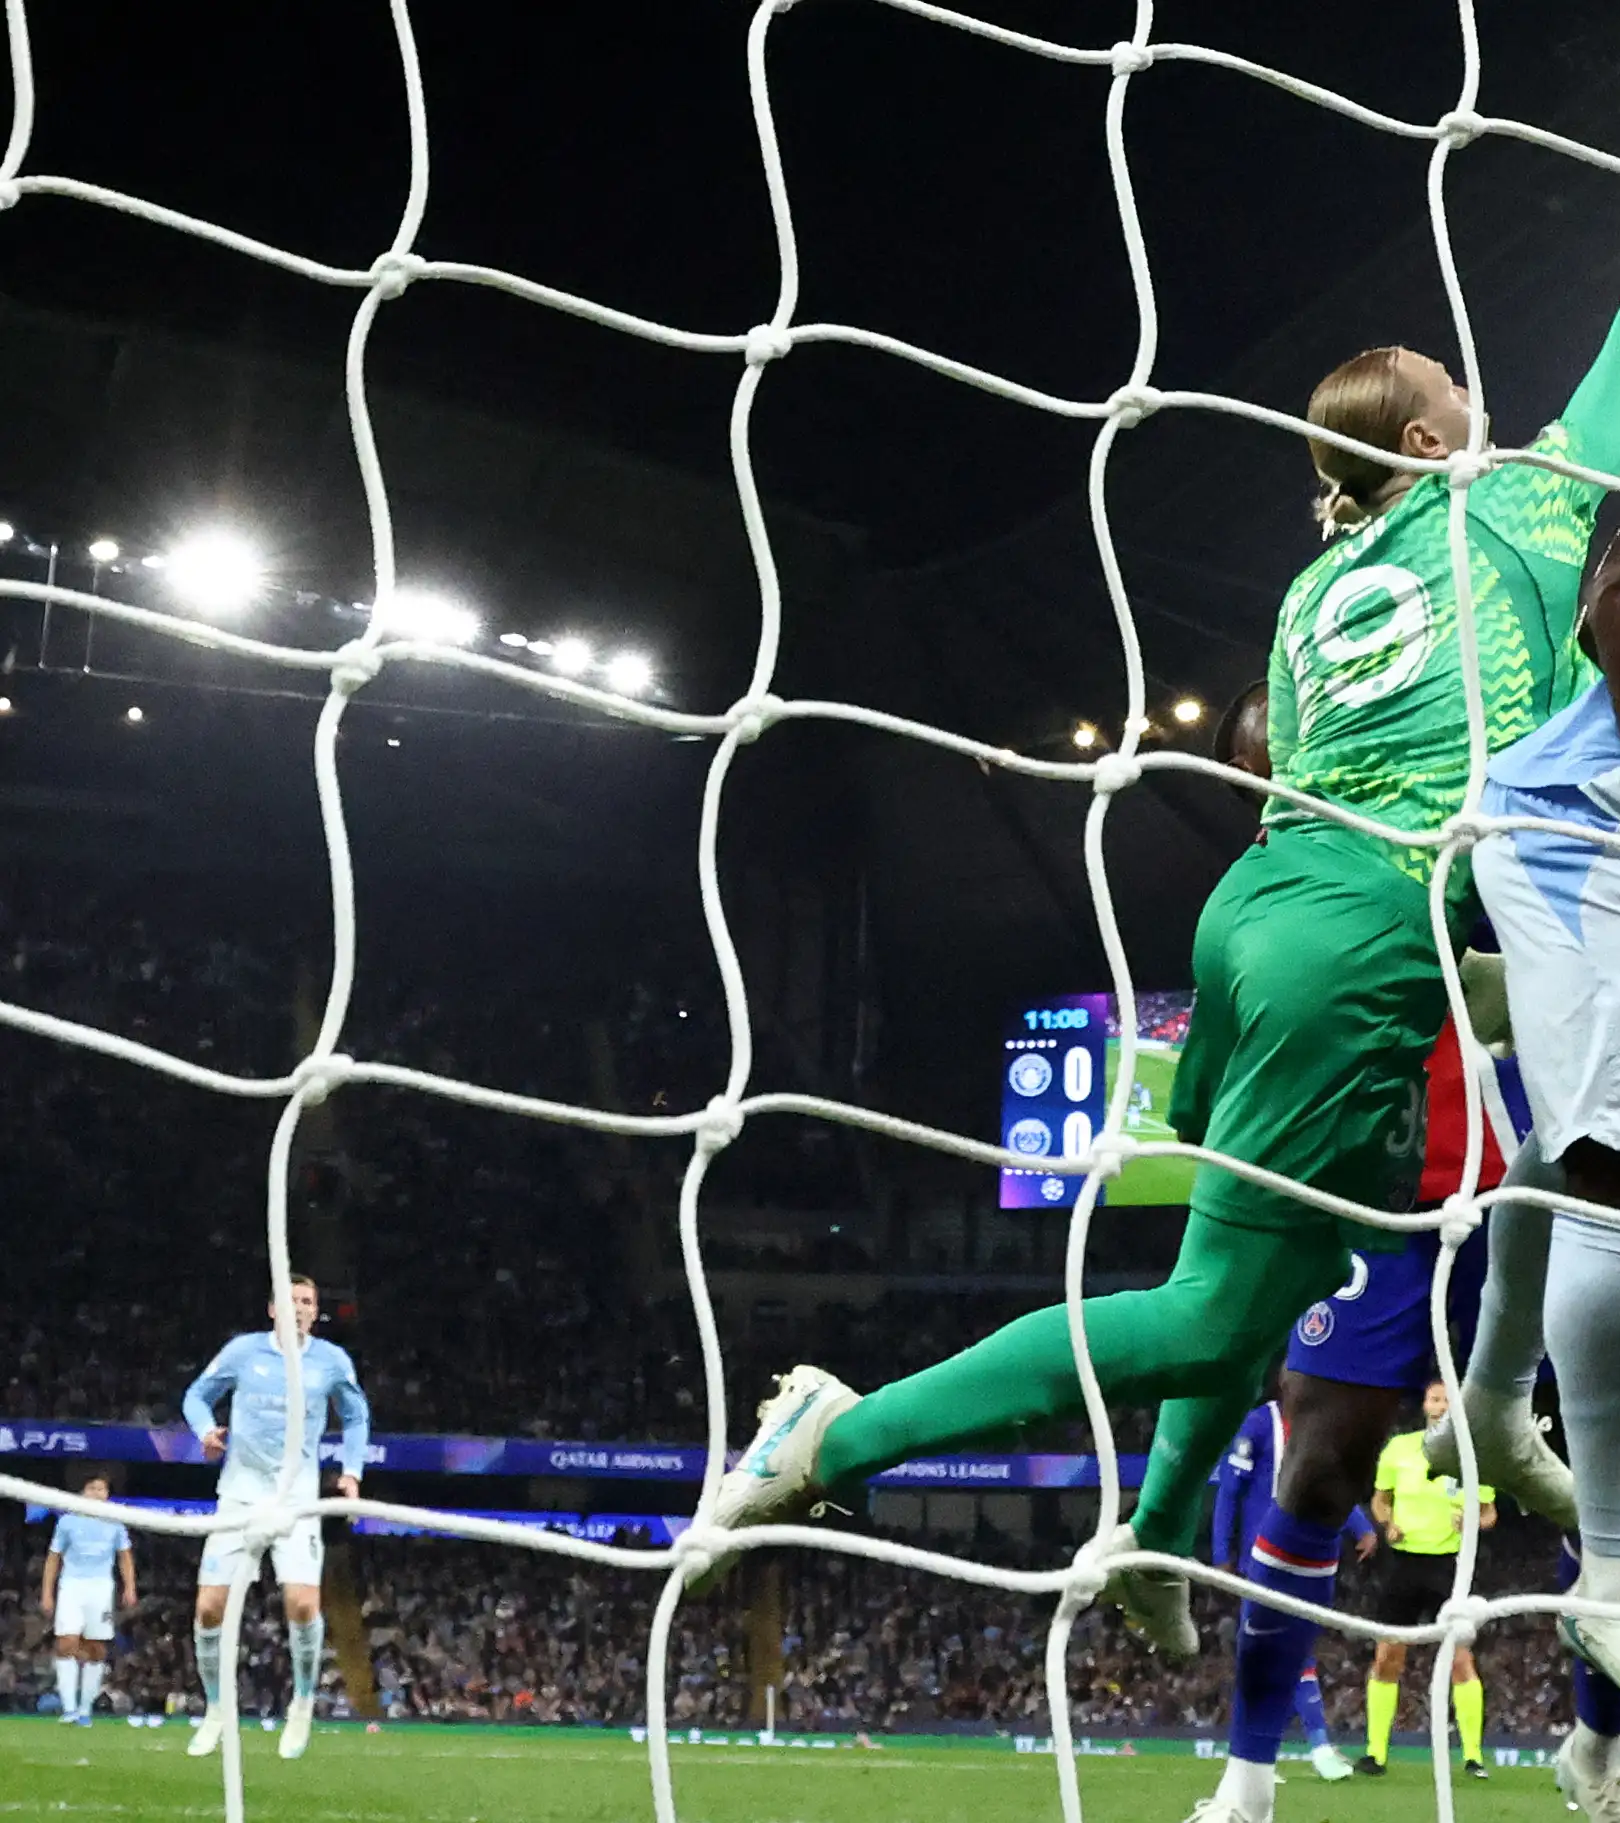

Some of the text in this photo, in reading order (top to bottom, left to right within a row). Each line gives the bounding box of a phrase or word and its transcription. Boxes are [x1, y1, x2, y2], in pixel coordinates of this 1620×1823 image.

[1063, 1046, 1092, 1102] 0
[1063, 1111, 1092, 1160] 0
[21, 1431, 88, 1452] PS5
[550, 1451, 608, 1470] QATAR
[949, 1463, 1011, 1478] LEAGUE
